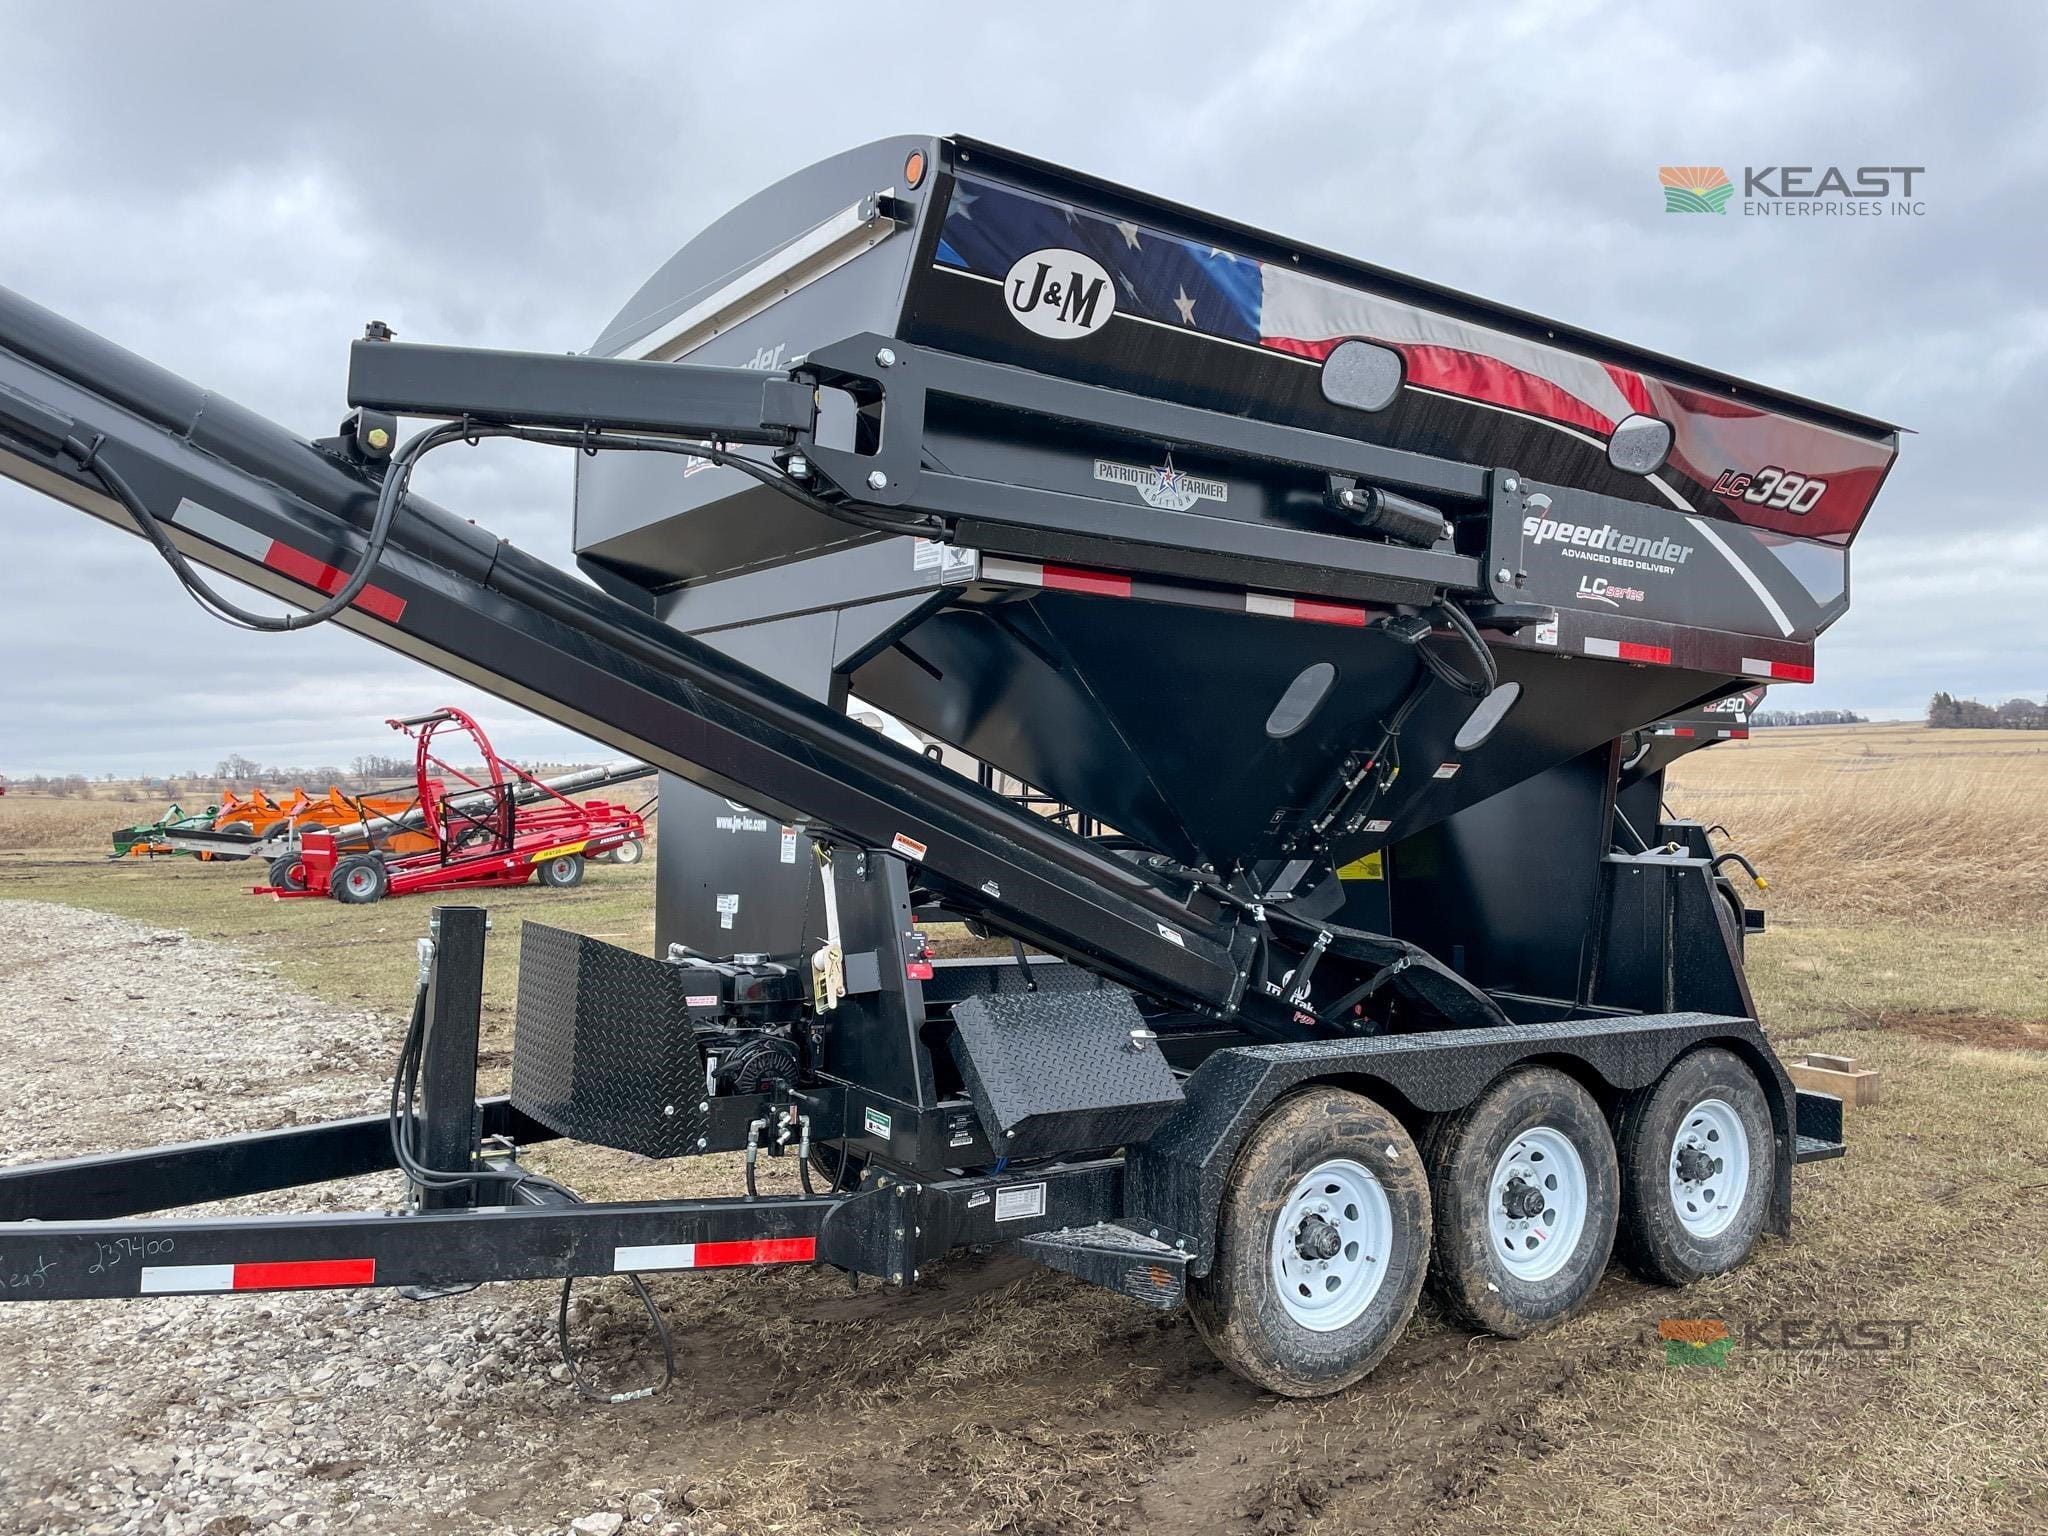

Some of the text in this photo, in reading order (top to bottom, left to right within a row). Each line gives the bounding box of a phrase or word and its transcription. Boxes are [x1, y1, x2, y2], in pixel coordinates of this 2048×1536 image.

[1012, 262, 1106, 329] J&M
[1099, 463, 1224, 498] PATRIOTIC FARMER
[1561, 548, 1675, 575] ADVANCED SEED DELIVERY
